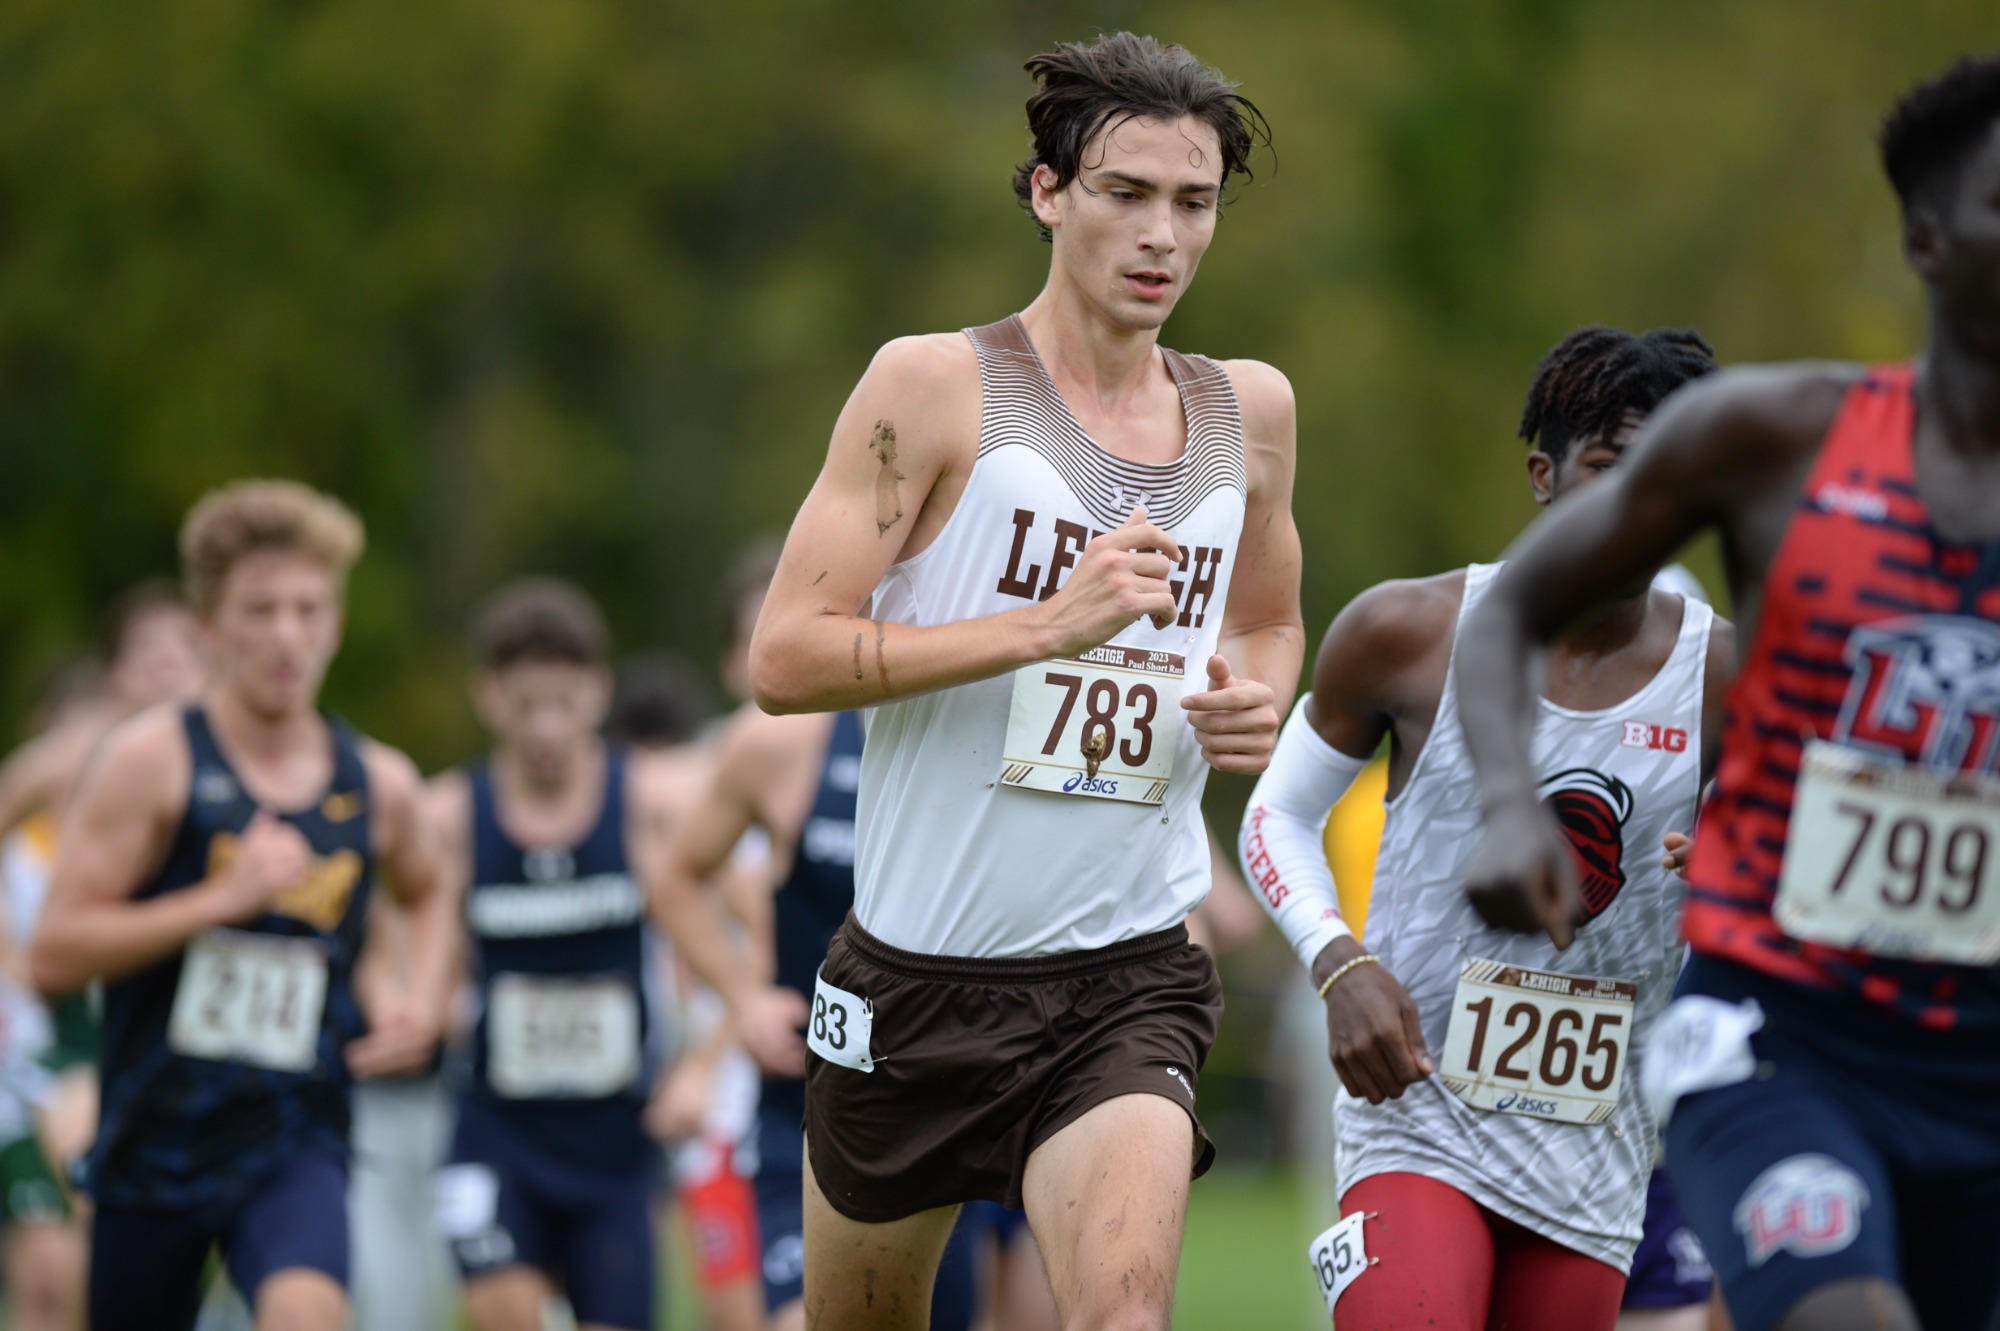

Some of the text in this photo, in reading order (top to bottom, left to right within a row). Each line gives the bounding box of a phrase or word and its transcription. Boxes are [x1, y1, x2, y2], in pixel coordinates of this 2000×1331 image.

[1128, 659, 1184, 674] Paul Short Run
[1148, 652, 1169, 663] 2023
[1041, 672, 1157, 767] 783
[1830, 800, 1988, 917] 799
[1520, 972, 1572, 994] LEHIGH
[1466, 996, 1623, 1091] 1265
